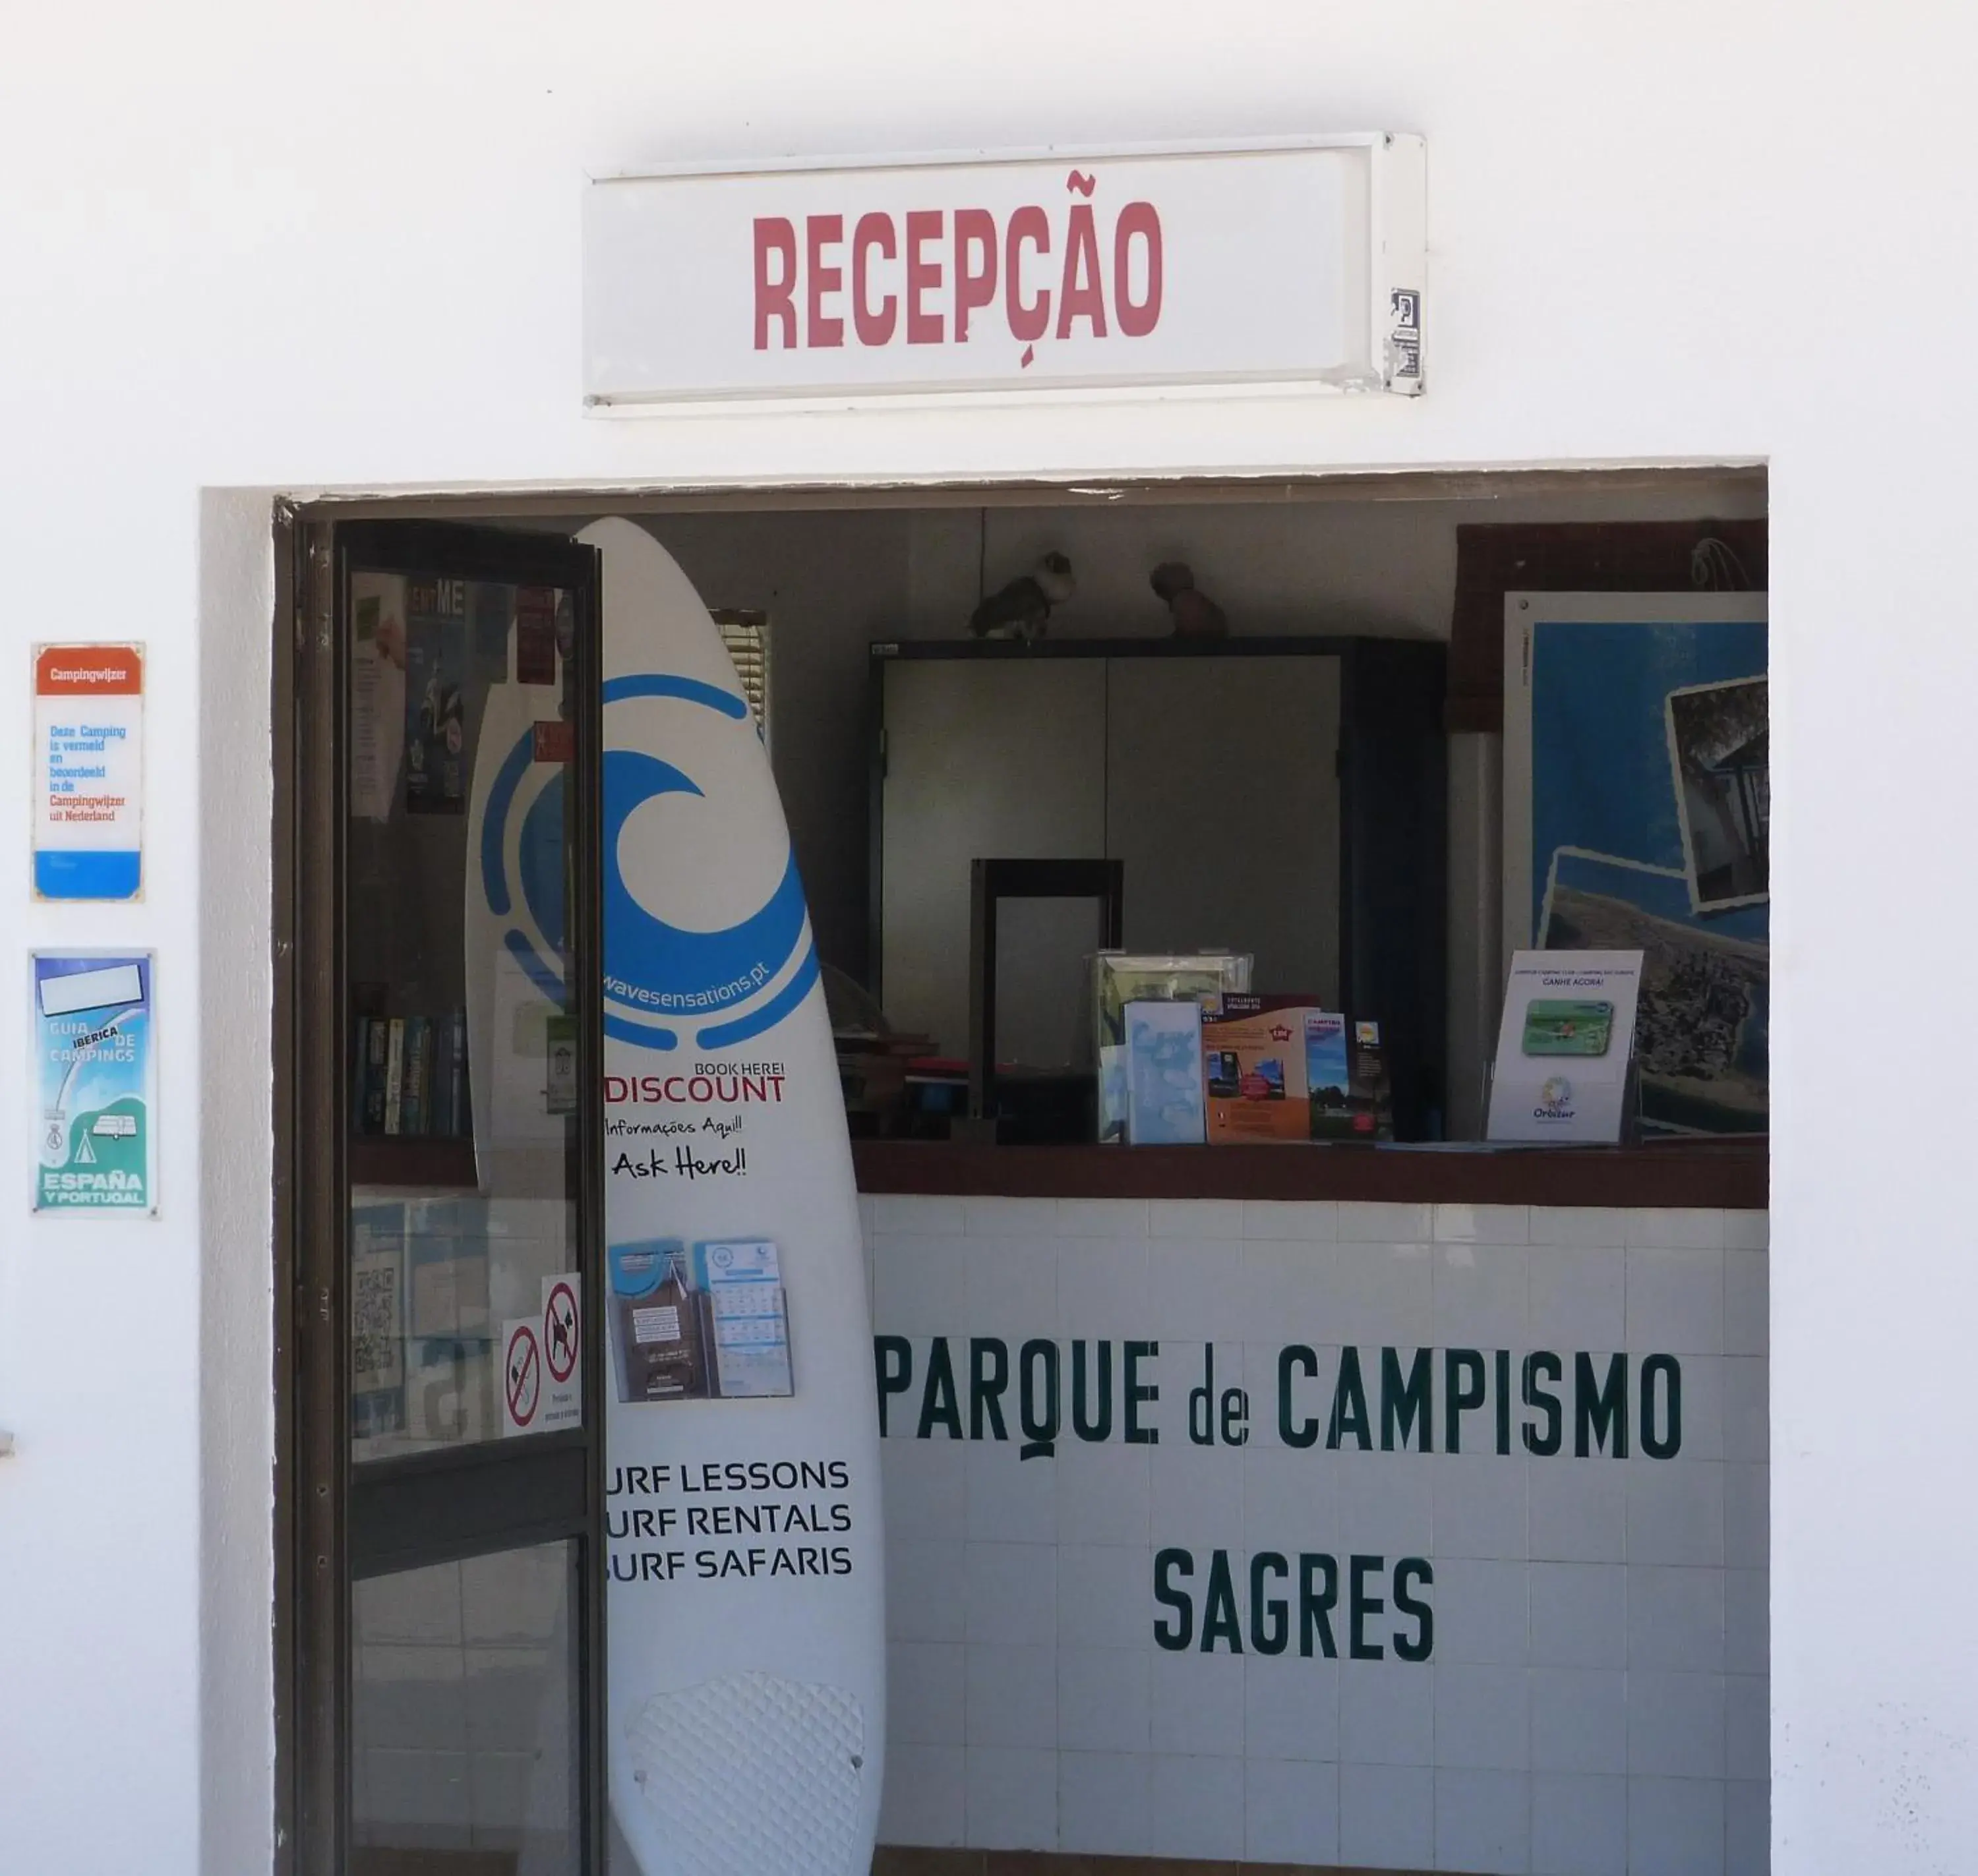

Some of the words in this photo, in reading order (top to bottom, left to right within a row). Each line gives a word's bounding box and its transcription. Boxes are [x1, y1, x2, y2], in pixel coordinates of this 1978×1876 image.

[752, 169, 1163, 368] RECEPÇÃO
[50, 667, 127, 683] Campingwijzer
[51, 726, 75, 737] Deze
[80, 725, 127, 740] Camping
[50, 740, 59, 751] is
[63, 740, 105, 751] vermeld
[50, 754, 63, 763] en
[50, 766, 105, 778] beoordeeld
[50, 781, 59, 792] in
[61, 780, 74, 792] de
[50, 795, 126, 809] Campingwijzer
[50, 811, 63, 821] uit
[66, 811, 115, 821] Nederland
[49, 1022, 88, 1035] GUIA
[73, 1026, 119, 1049] IBERICA
[115, 1034, 135, 1047] DE
[49, 1049, 135, 1063] CAMPINGS
[695, 1063, 738, 1075] BOOK
[742, 1062, 785, 1075] HERE!
[605, 1076, 785, 1103] DISCOUNT
[605, 1118, 696, 1137] Informações
[611, 1149, 668, 1179] Ask
[676, 1145, 747, 1180] Here!!
[44, 1169, 143, 1190] ESPAÑA
[45, 1191, 55, 1203] Y
[57, 1191, 144, 1204] PORTUGAL
[875, 1335, 1159, 1461] PARQUE
[1188, 1342, 1249, 1446] de
[1277, 1344, 1683, 1460] CAMPISMO
[606, 1465, 671, 1495] URF
[681, 1461, 849, 1492] LESSONS
[606, 1508, 676, 1539] URF
[687, 1504, 852, 1536] RENTALS
[606, 1552, 684, 1582] URF
[695, 1547, 853, 1579] SAFARIS
[1153, 1546, 1435, 1662] SAGRES
